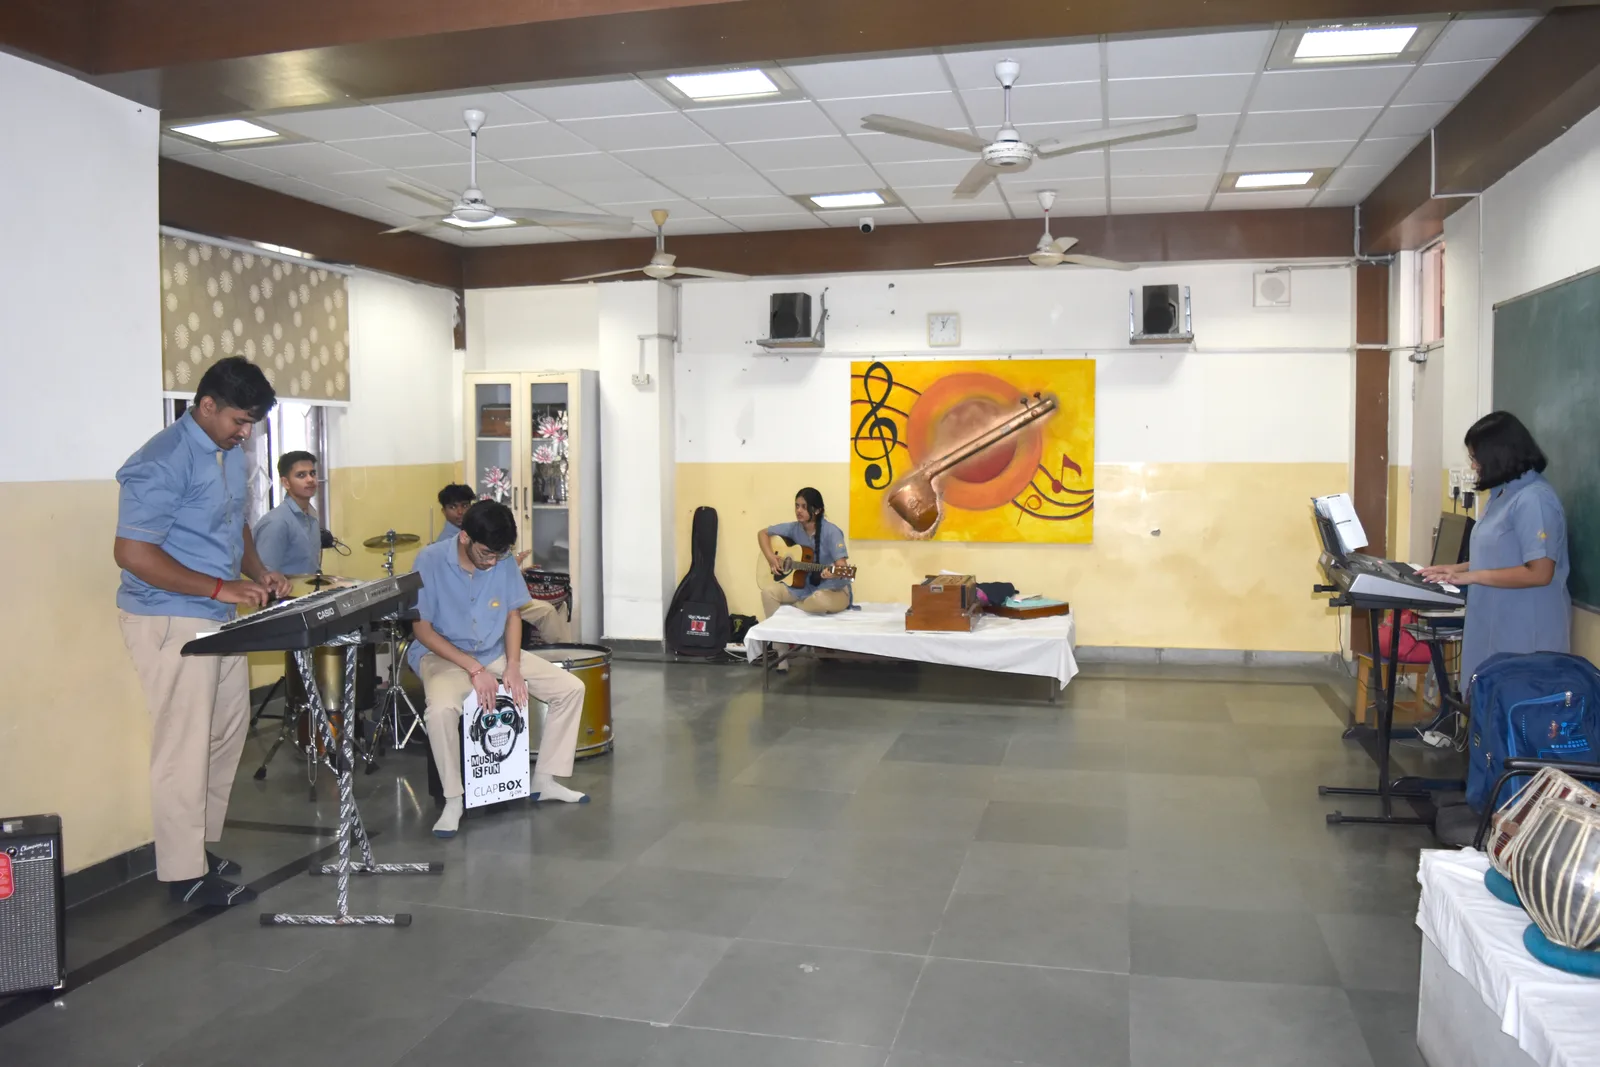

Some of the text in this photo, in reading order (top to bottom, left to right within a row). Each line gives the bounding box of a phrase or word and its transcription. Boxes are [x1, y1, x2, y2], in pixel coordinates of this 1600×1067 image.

[317, 607, 335, 620] CASIO
[471, 752, 500, 767] MUSIC
[472, 763, 500, 778] IS FUN
[474, 779, 522, 797] CLAPBOX
